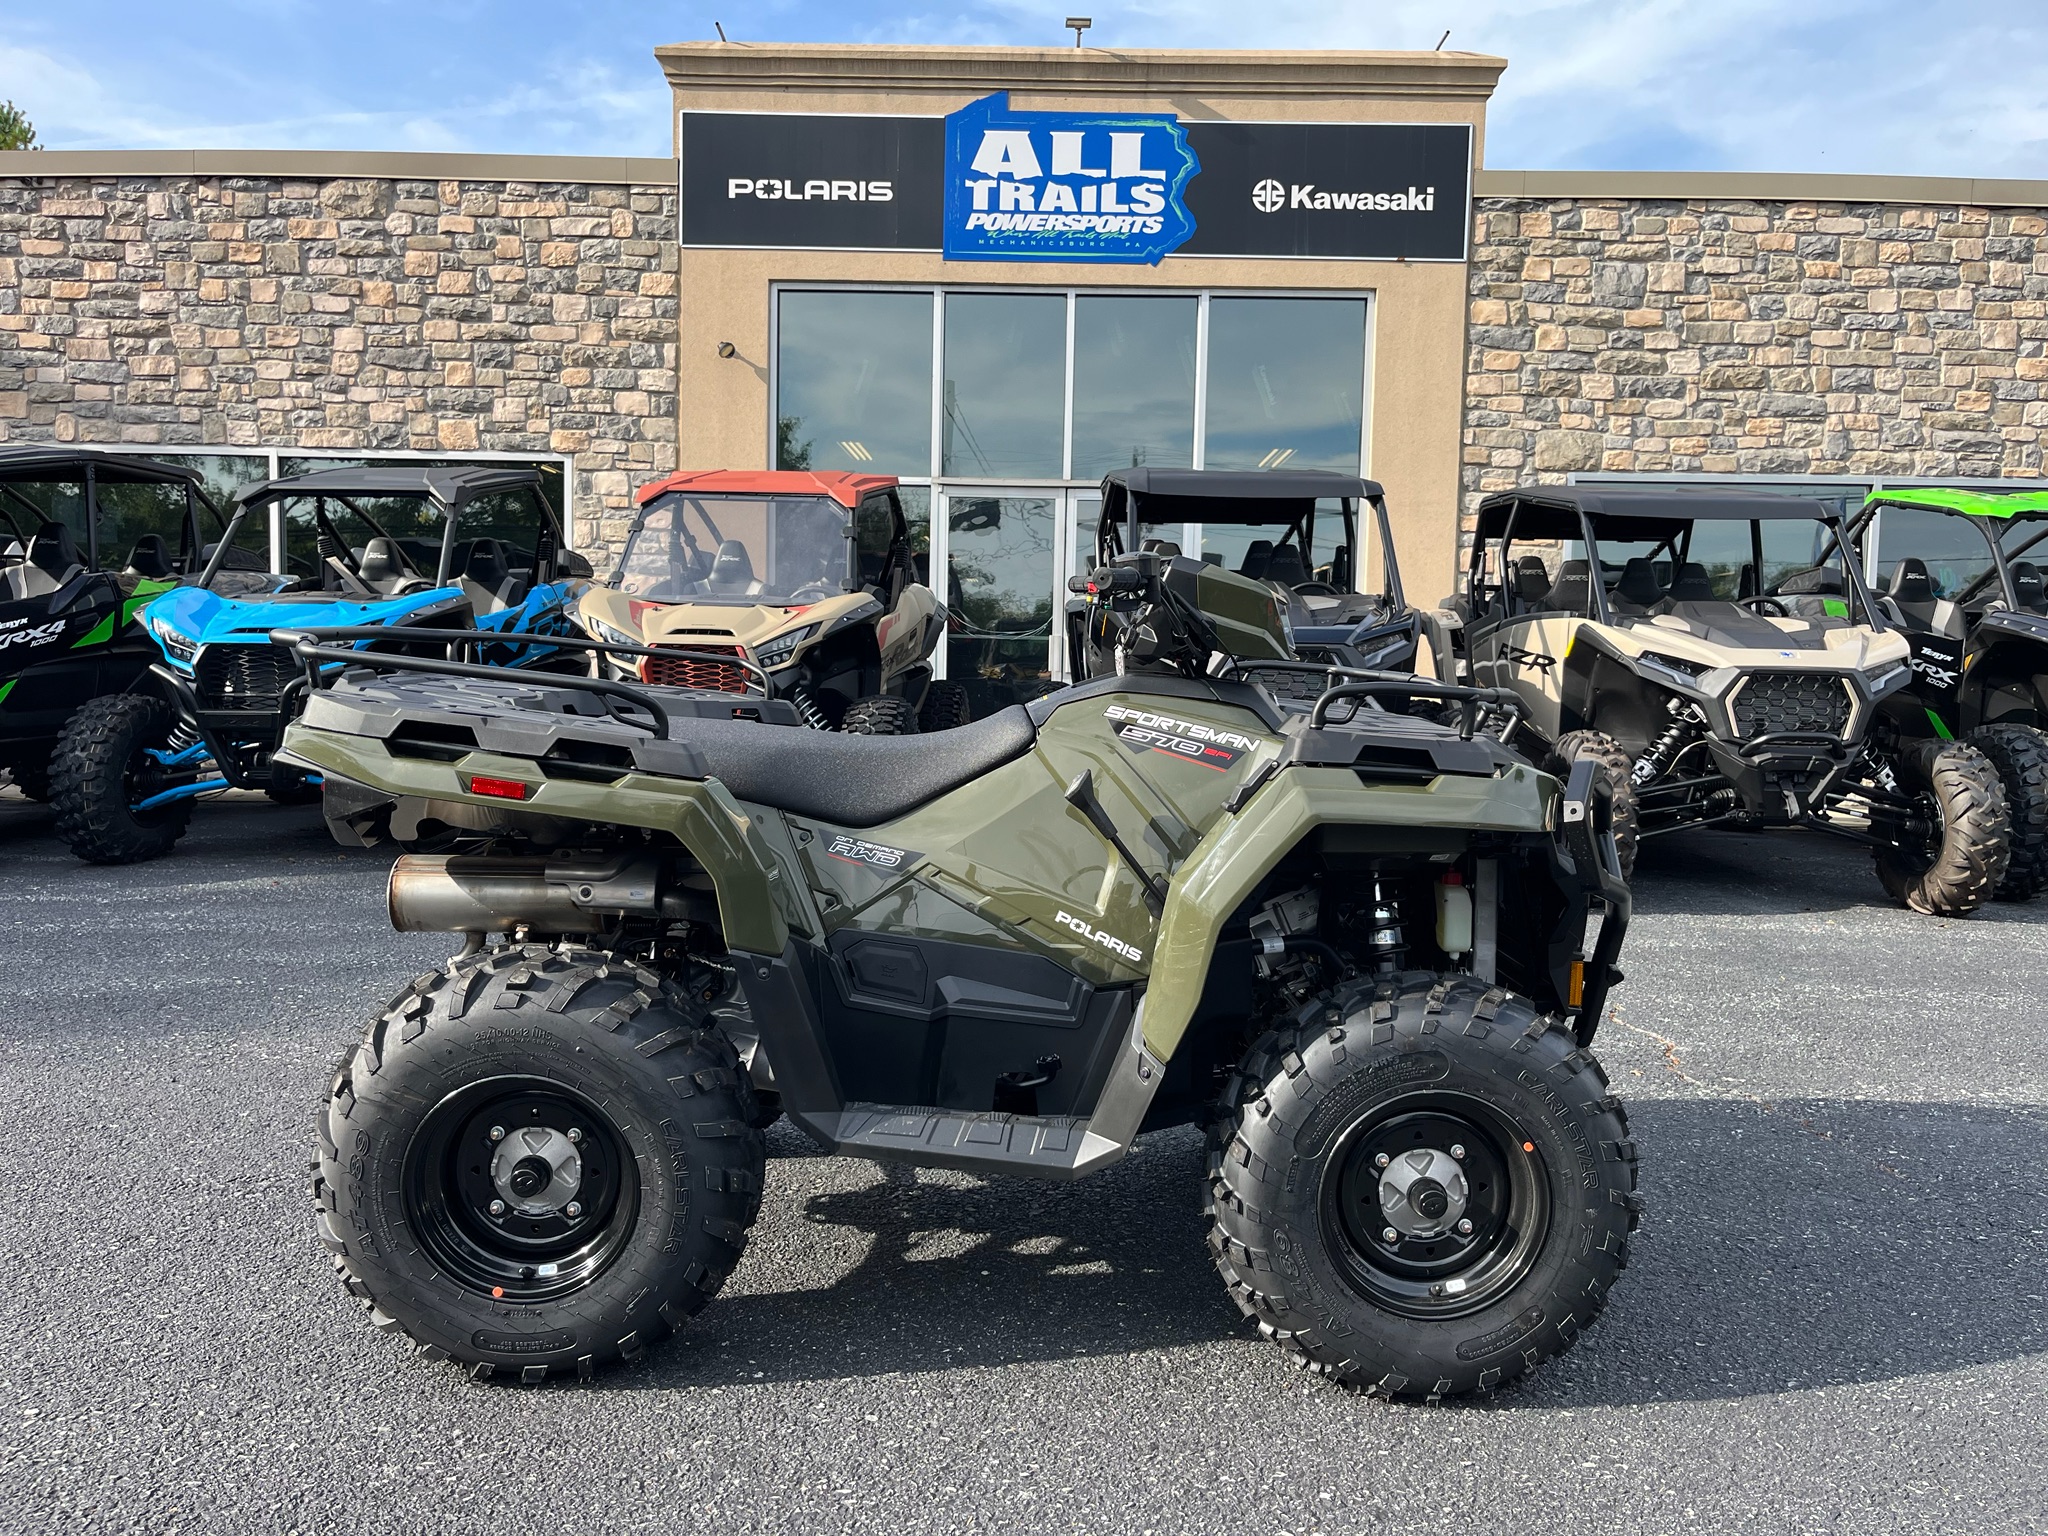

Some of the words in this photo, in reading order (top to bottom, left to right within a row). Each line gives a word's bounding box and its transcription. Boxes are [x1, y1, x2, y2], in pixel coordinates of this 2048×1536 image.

[970, 130, 1167, 182] ALL
[728, 178, 894, 202] POLARIS
[964, 179, 1167, 215] TRAILS
[1290, 184, 1435, 211] Kawasaki
[964, 212, 1165, 234] POWERSPORTS
[29, 634, 59, 648] 1000
[1498, 642, 1558, 676] RZR
[1925, 676, 1949, 689] 1000
[1101, 704, 1262, 752] SPORTSMAN
[1118, 725, 1205, 756] 570
[828, 840, 901, 867] AWD
[1054, 909, 1143, 962] POLARIS
[1516, 1068, 1599, 1190] CARLSTAR
[348, 1129, 381, 1258] AT489
[658, 1117, 691, 1257] CARLSTAR
[1273, 1228, 1354, 1339] AT489
